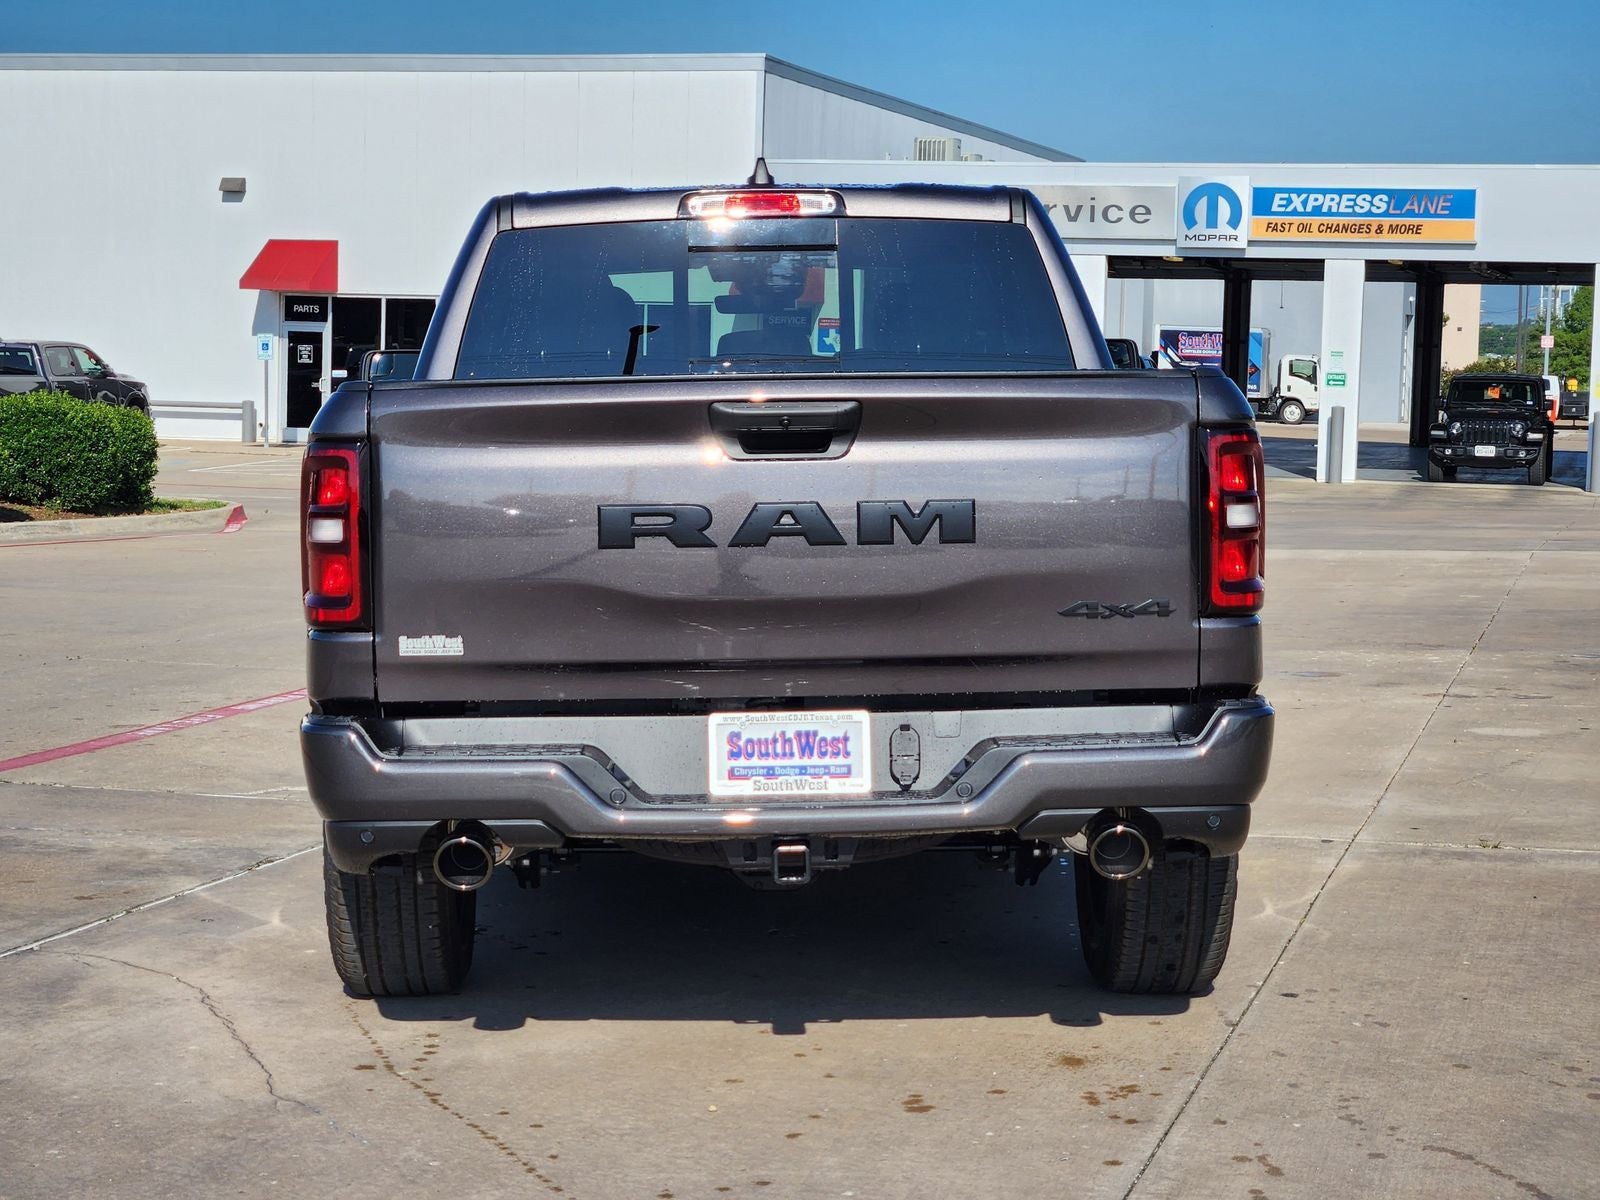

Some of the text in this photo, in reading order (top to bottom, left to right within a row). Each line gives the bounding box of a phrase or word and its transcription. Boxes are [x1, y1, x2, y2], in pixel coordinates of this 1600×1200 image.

[1265, 222, 1423, 235] FAST OIL CHANGES & MORE
[1184, 234, 1239, 242] MOPAR
[293, 304, 320, 313] PARTS
[768, 315, 807, 325] SERVICE
[597, 499, 976, 549] RAM
[398, 634, 463, 649] SouthWest
[726, 729, 851, 761] SouthWest
[734, 765, 848, 776] Chrysler Dodge Jeep Ram
[753, 778, 829, 791] SouthWest
